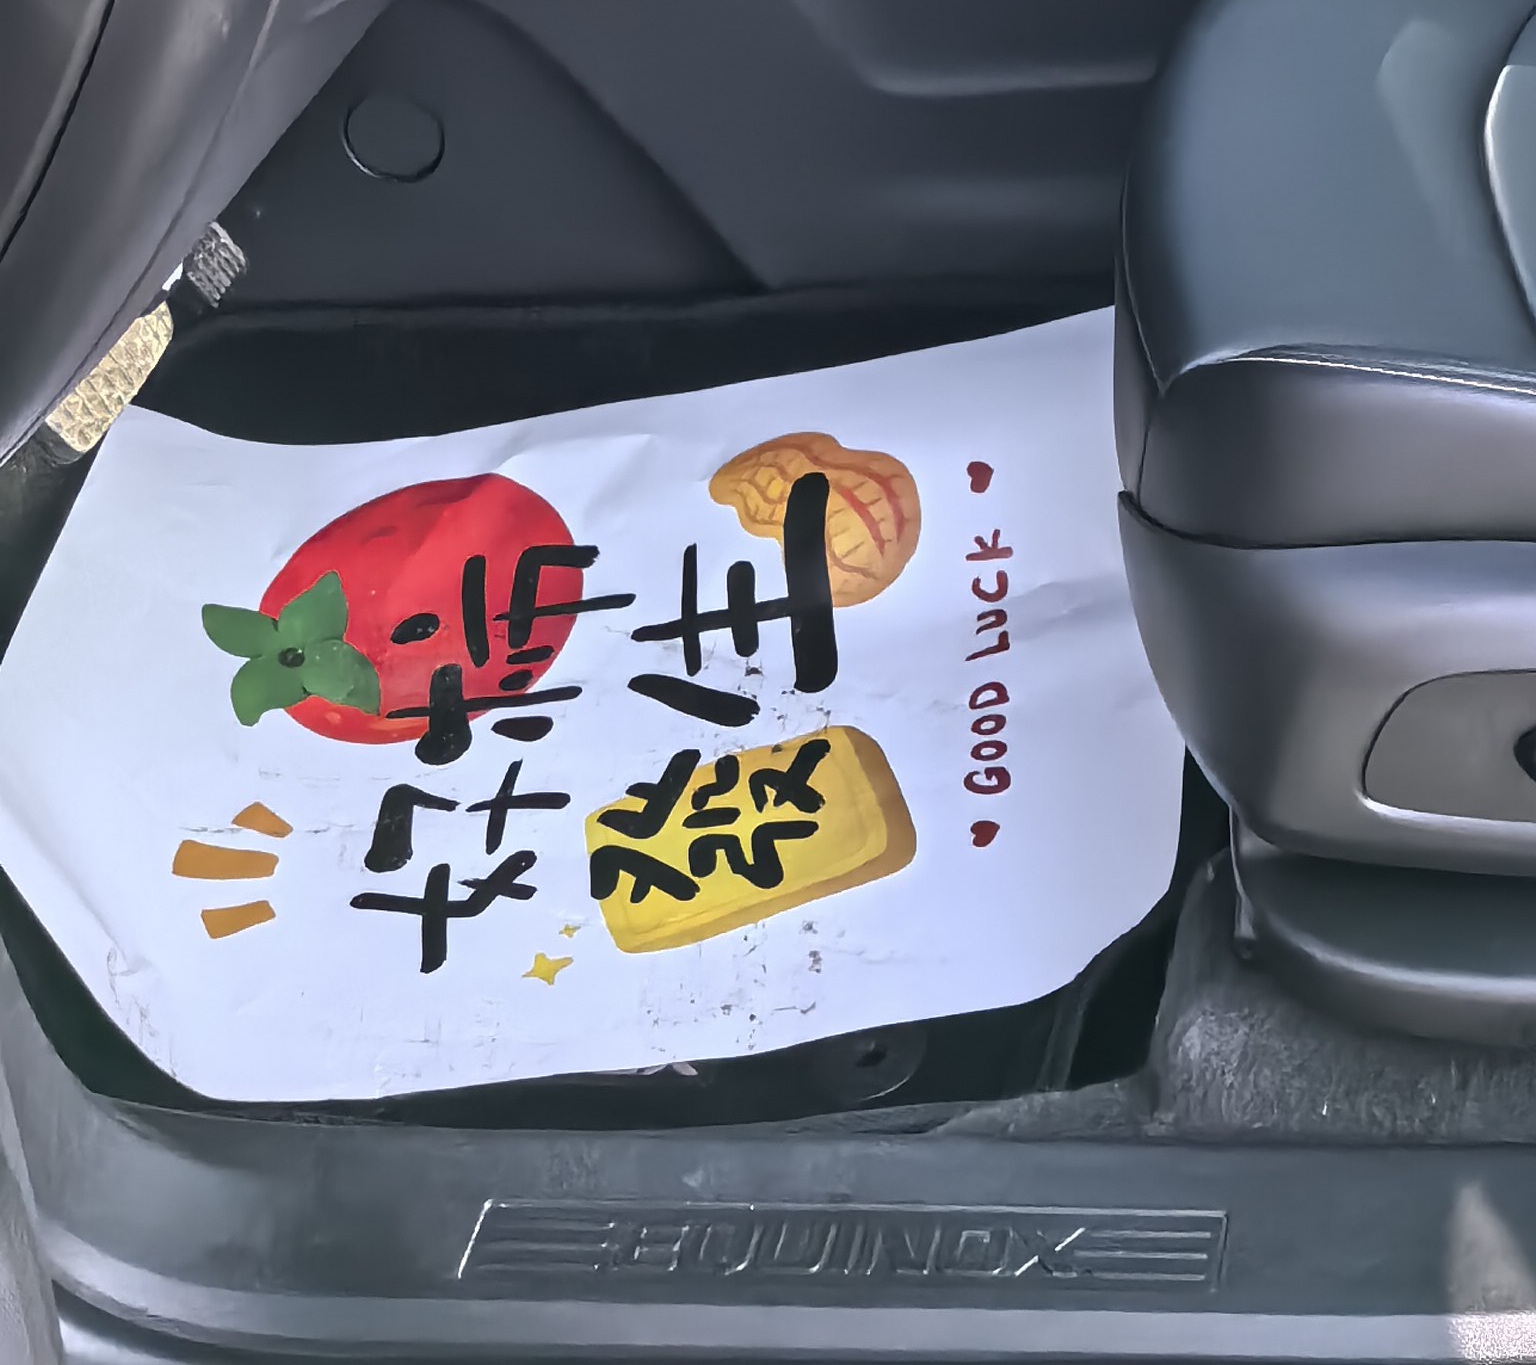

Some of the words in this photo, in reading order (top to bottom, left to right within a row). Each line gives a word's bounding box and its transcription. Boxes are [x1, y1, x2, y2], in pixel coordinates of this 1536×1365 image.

[964, 528, 1014, 662] LUCK
[591, 472, 838, 901] 發生
[963, 681, 1011, 795] GOOD
[350, 545, 636, 973] 好柿
[611, 1222, 1087, 1277] EQUINOX
